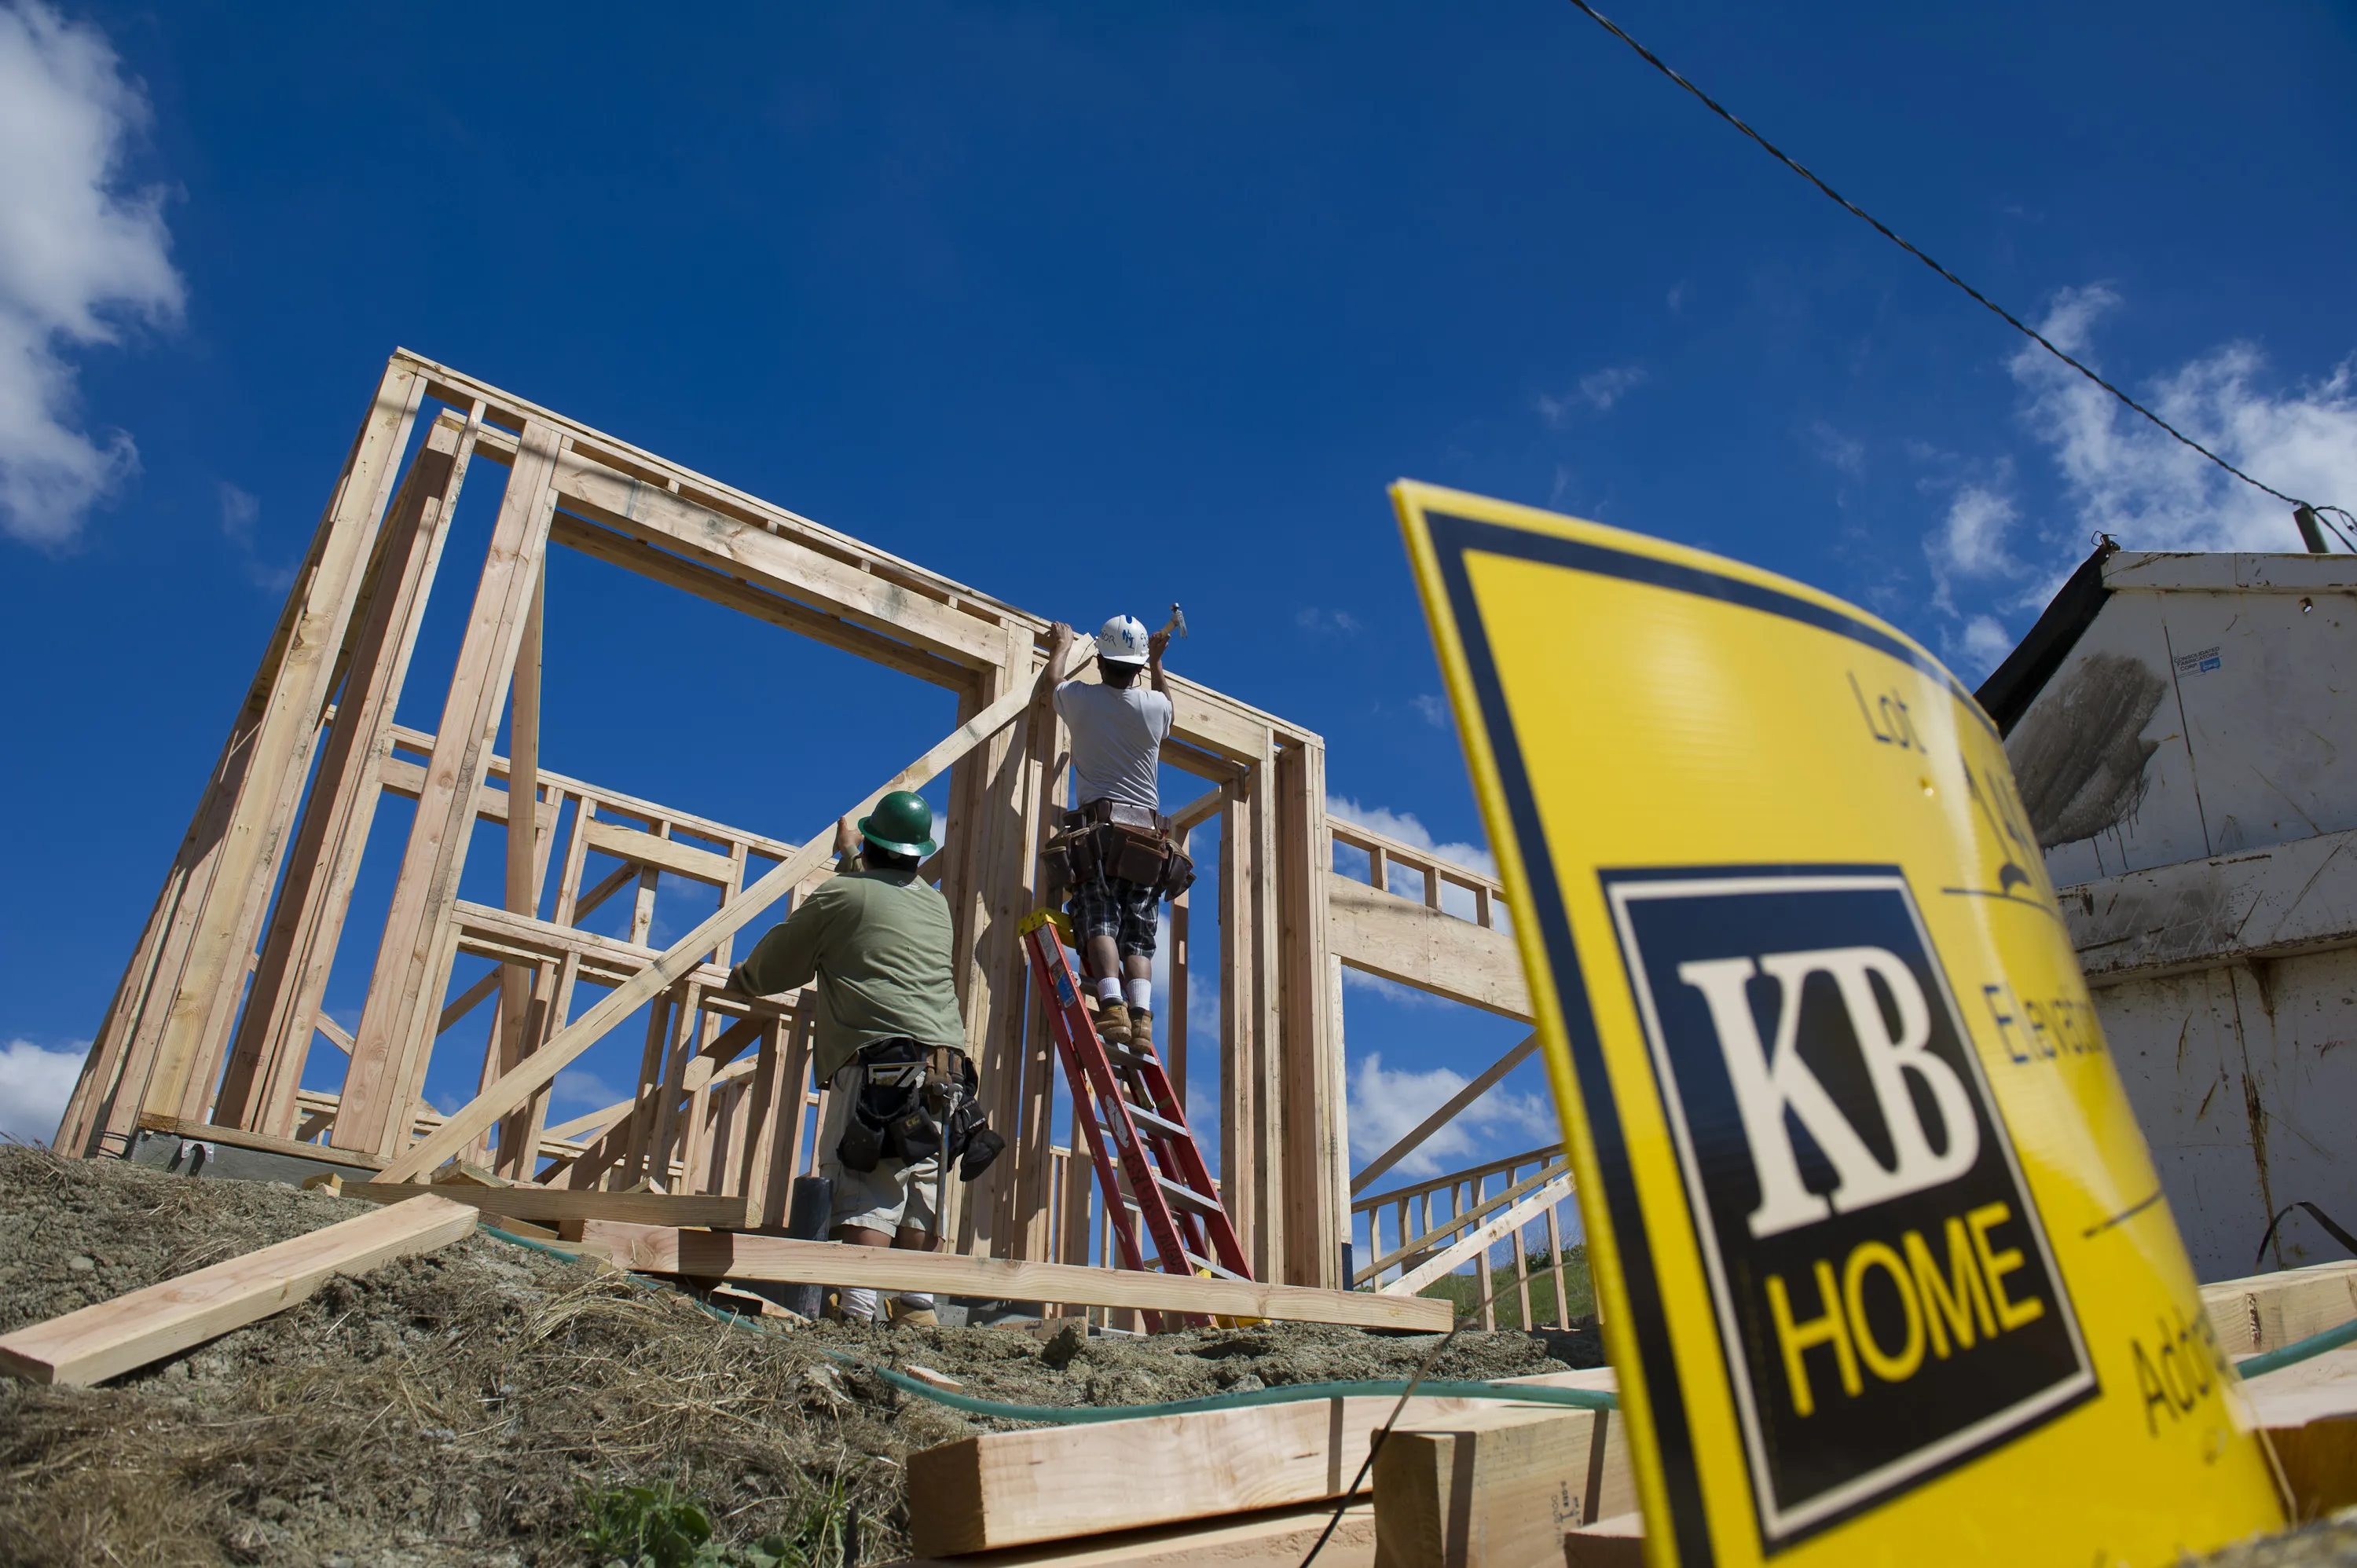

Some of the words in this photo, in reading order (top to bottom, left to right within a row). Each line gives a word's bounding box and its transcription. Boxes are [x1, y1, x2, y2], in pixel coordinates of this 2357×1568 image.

[2174, 647, 2220, 663] CONSOLIDATED
[2177, 652, 2219, 667] FABRICATORS
[1846, 669, 1928, 755] Lot
[1678, 947, 1981, 1240] KB
[1765, 1202, 2045, 1417] HOME
